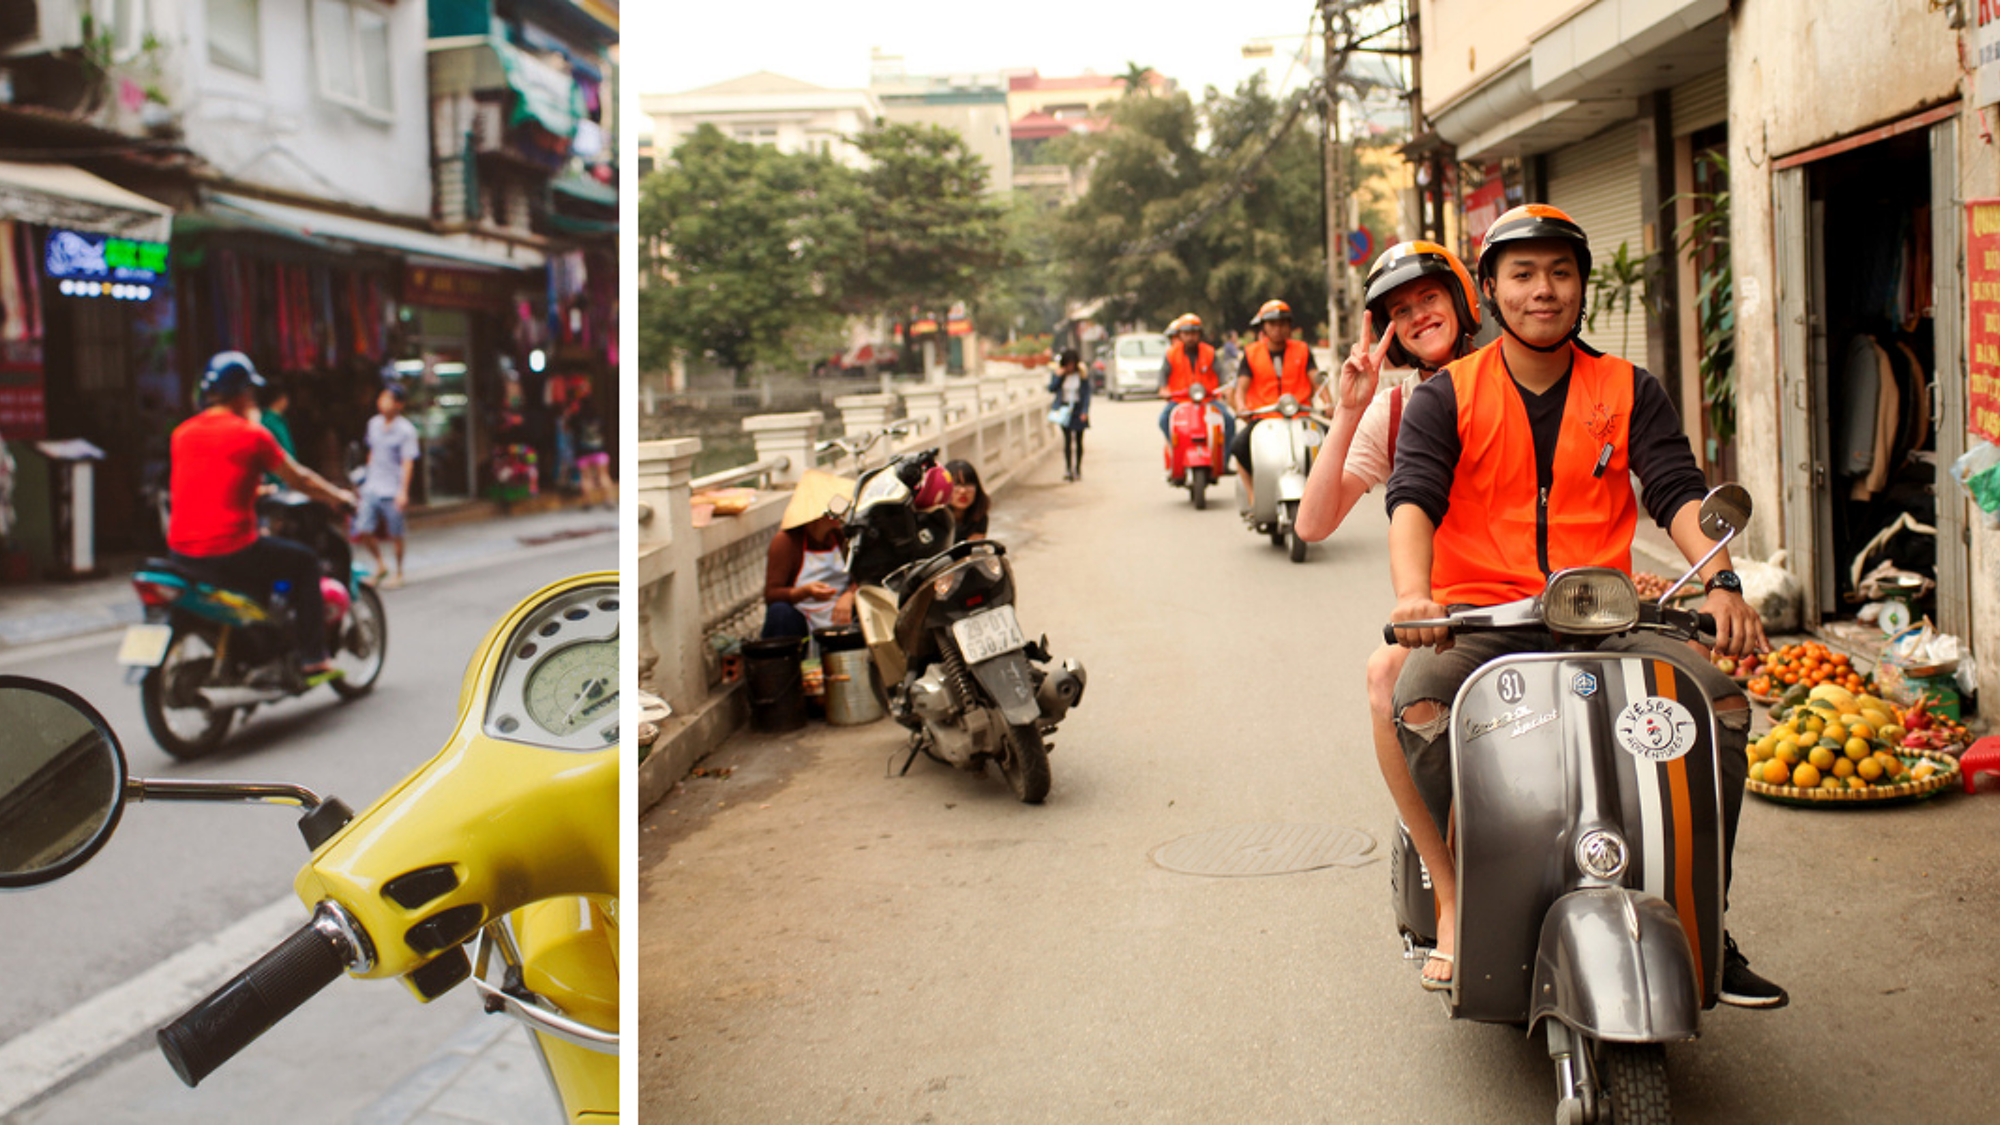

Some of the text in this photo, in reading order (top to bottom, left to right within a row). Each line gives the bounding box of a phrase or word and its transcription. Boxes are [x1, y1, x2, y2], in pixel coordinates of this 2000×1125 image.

[1501, 672, 1522, 700] 31
[1626, 700, 1672, 722] VESPA
[1627, 735, 1683, 759] ADVENTURES
